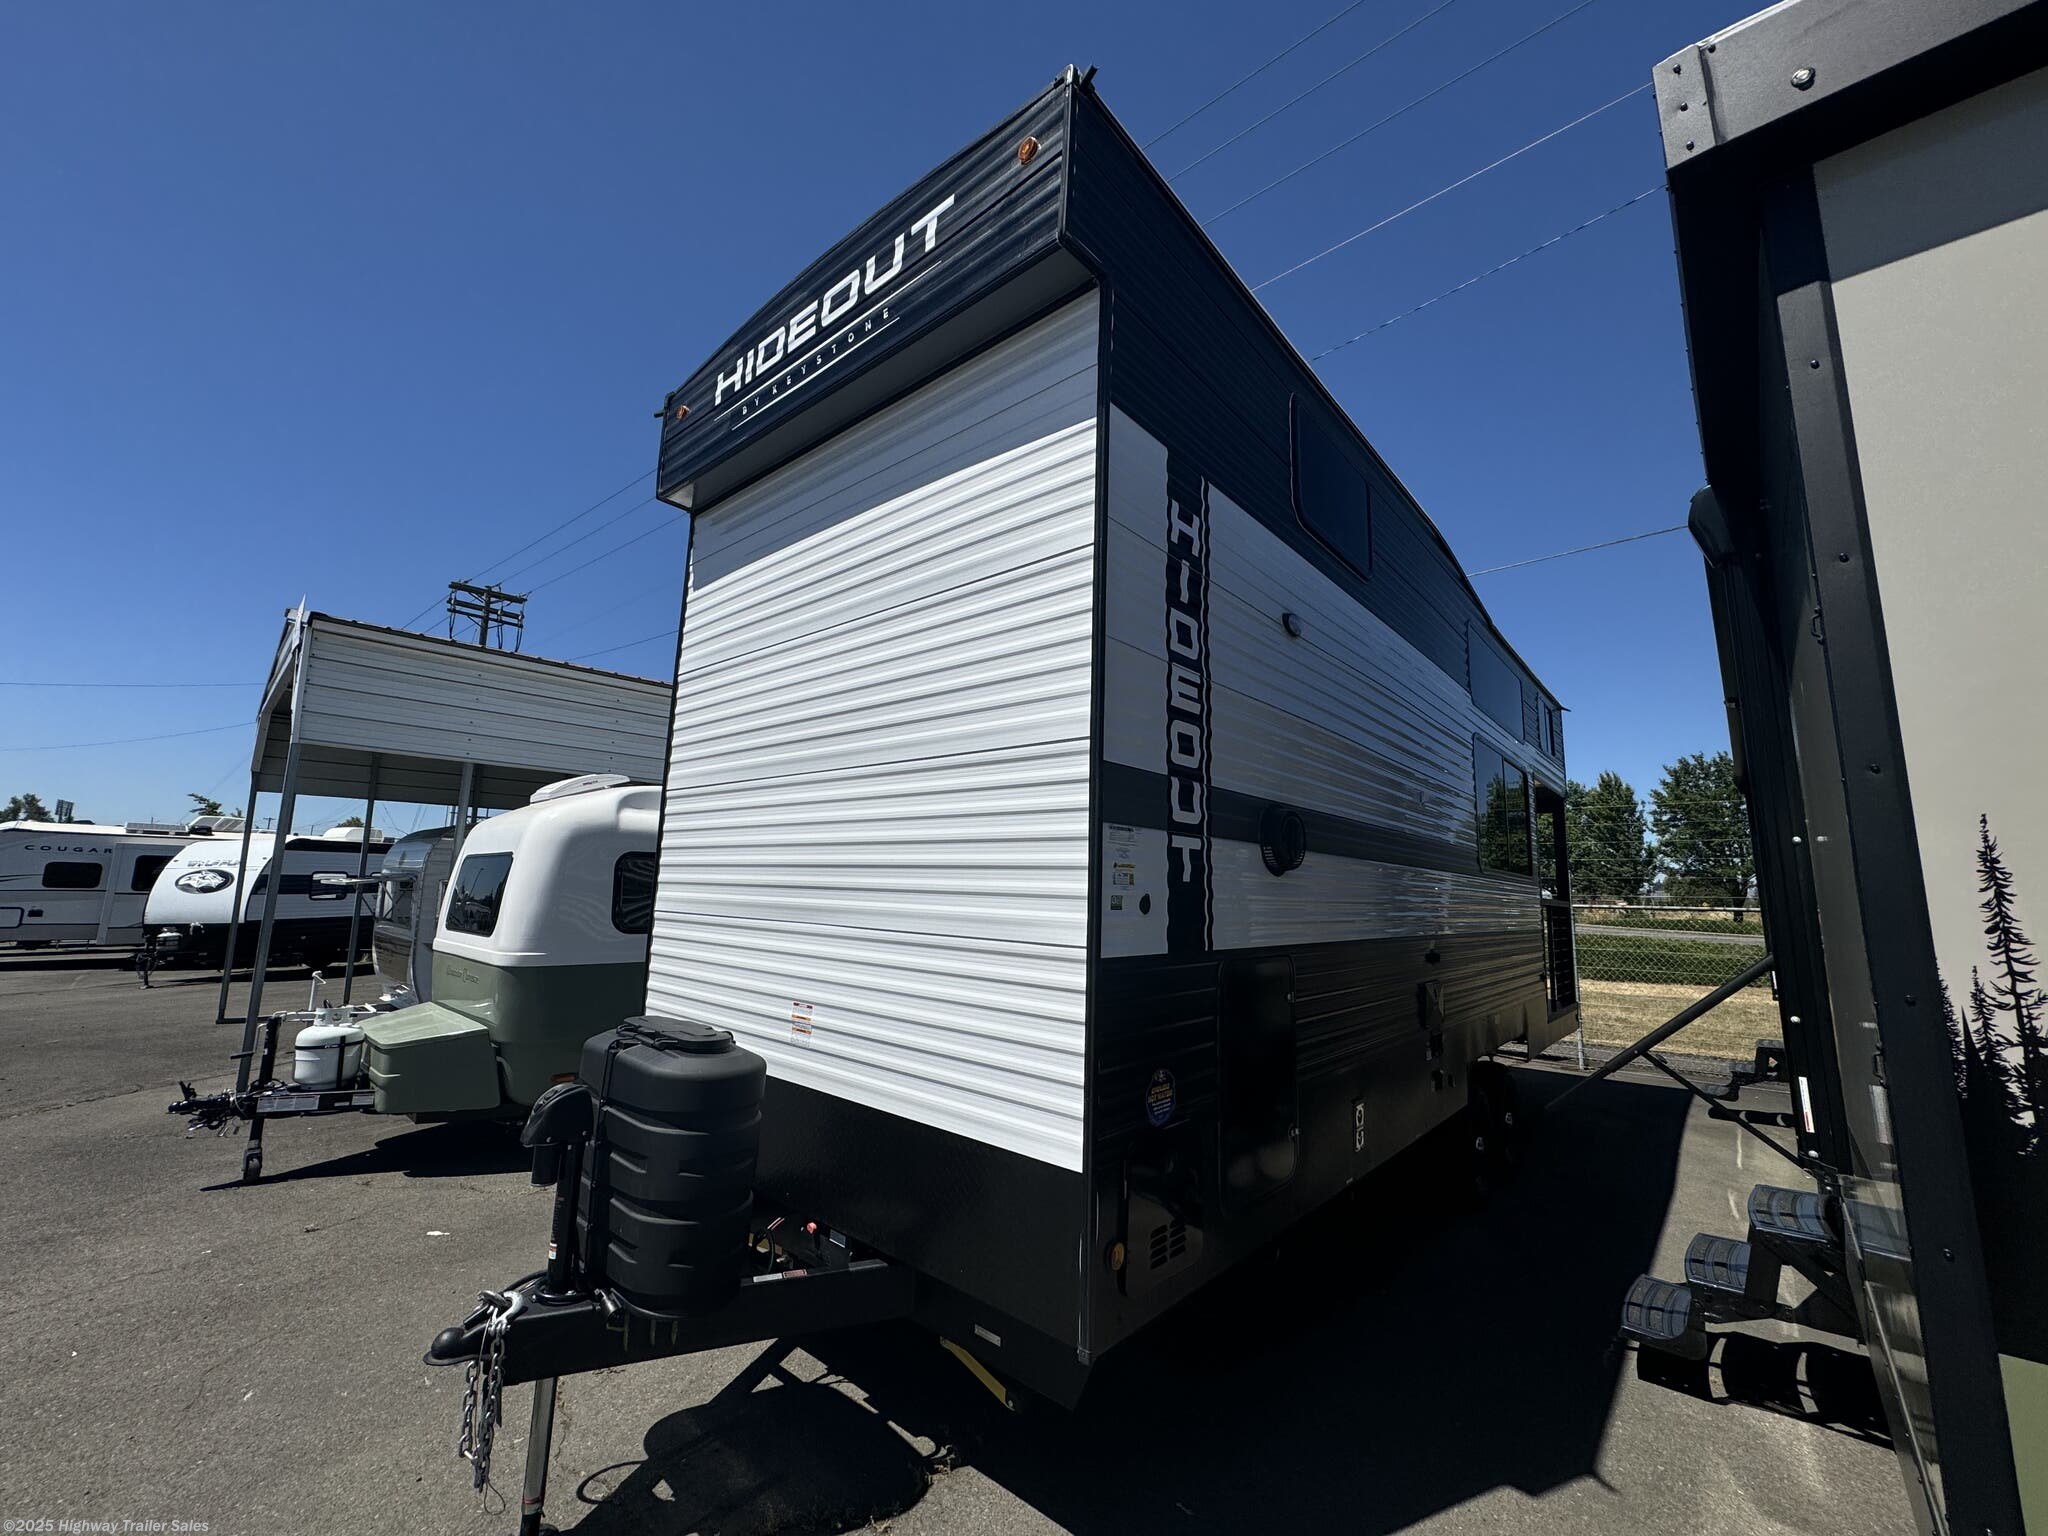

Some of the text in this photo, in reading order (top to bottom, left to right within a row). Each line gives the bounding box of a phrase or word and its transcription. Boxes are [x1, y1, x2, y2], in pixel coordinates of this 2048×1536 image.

[714, 194, 955, 406] HIDEOUT
[742, 308, 889, 415] BY KEYSTONE
[1170, 498, 1201, 882] HIDEOUT
[24, 845, 112, 854] COUGAR
